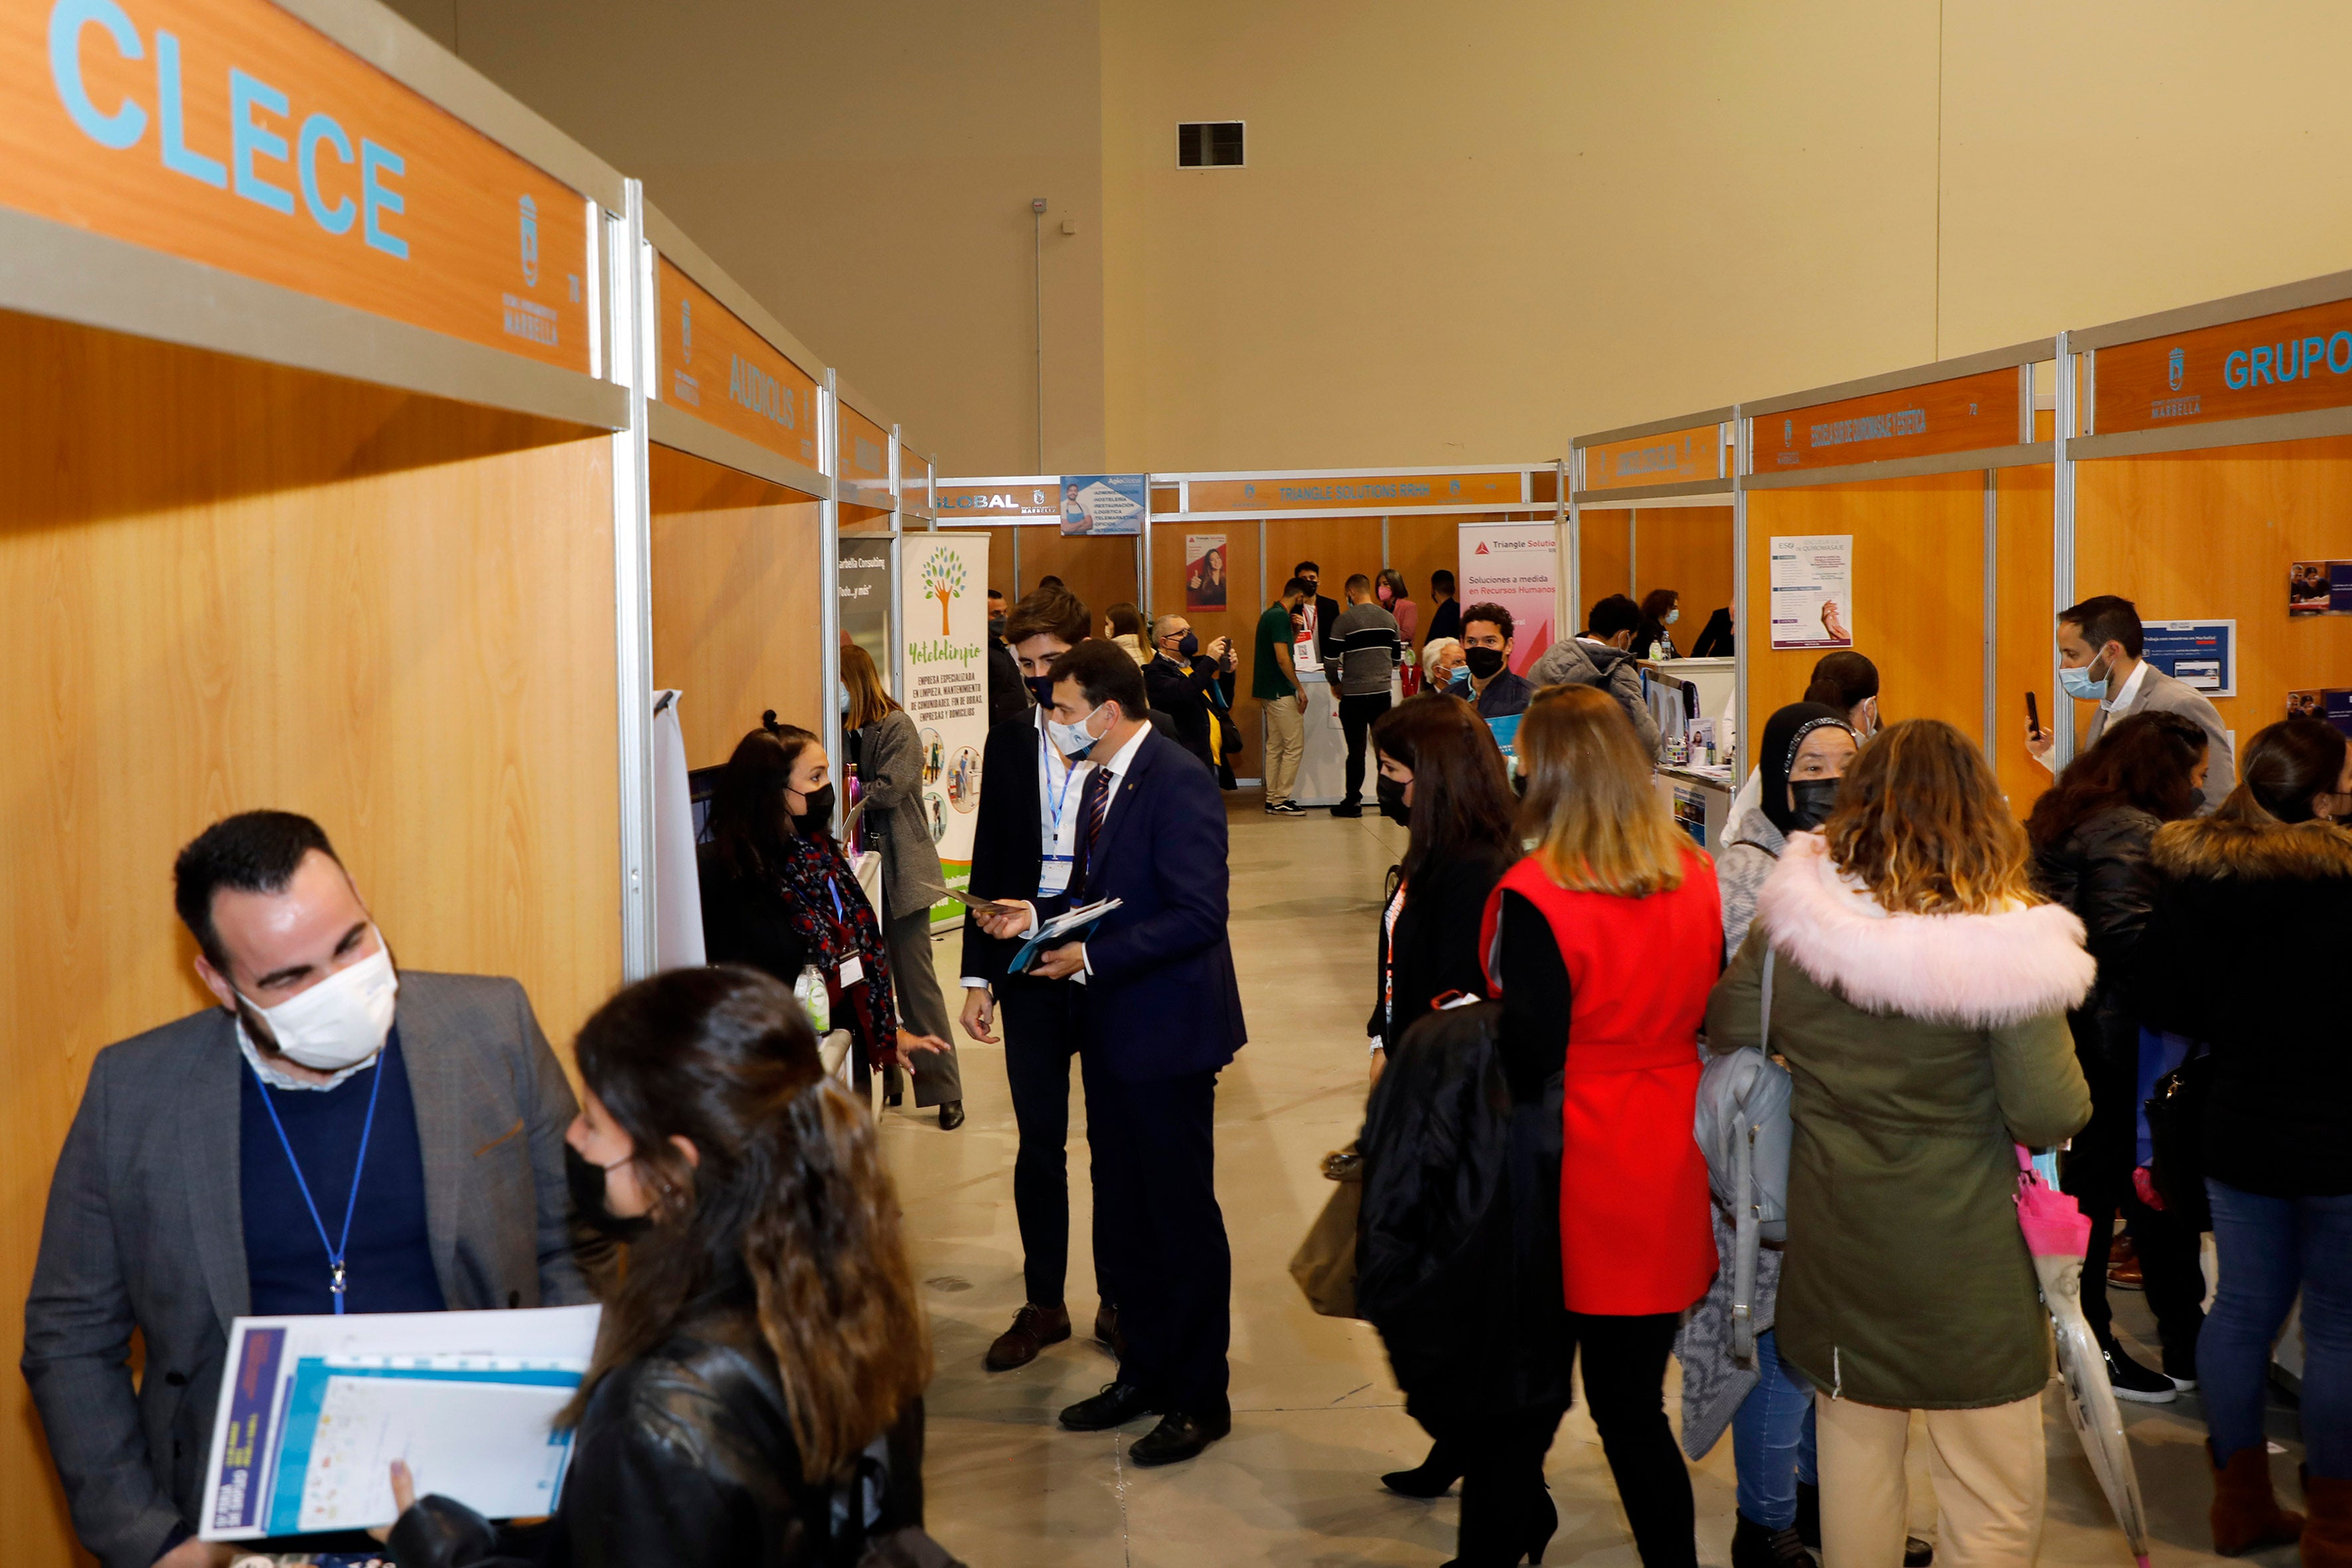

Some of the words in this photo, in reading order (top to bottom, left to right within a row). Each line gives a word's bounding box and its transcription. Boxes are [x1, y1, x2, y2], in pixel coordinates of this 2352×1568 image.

[48, 0, 409, 260] CLECE
[2225, 331, 2352, 390] GRUPO
[730, 353, 794, 430] AUDIOLIS
[2152, 402, 2201, 420] MARBELLA
[1279, 487, 1332, 501] TRIANGLE
[1336, 484, 1396, 500] SOLUTIONS
[1399, 483, 1430, 497] RRHH
[936, 494, 1019, 509] LOBAL
[839, 558, 858, 568] arbella
[858, 557, 885, 570] Consulting
[918, 675, 939, 686] EMPRESA
[941, 672, 975, 683] ESPECIALIZADA
[913, 689, 919, 698] EN
[943, 684, 980, 694] MANTENIMIENTO
[911, 701, 917, 710] DE
[960, 696, 965, 705] DE
[919, 711, 944, 722] EMPRESAS
[945, 710, 949, 719] Y
[949, 708, 975, 718] DOMICILIOS
